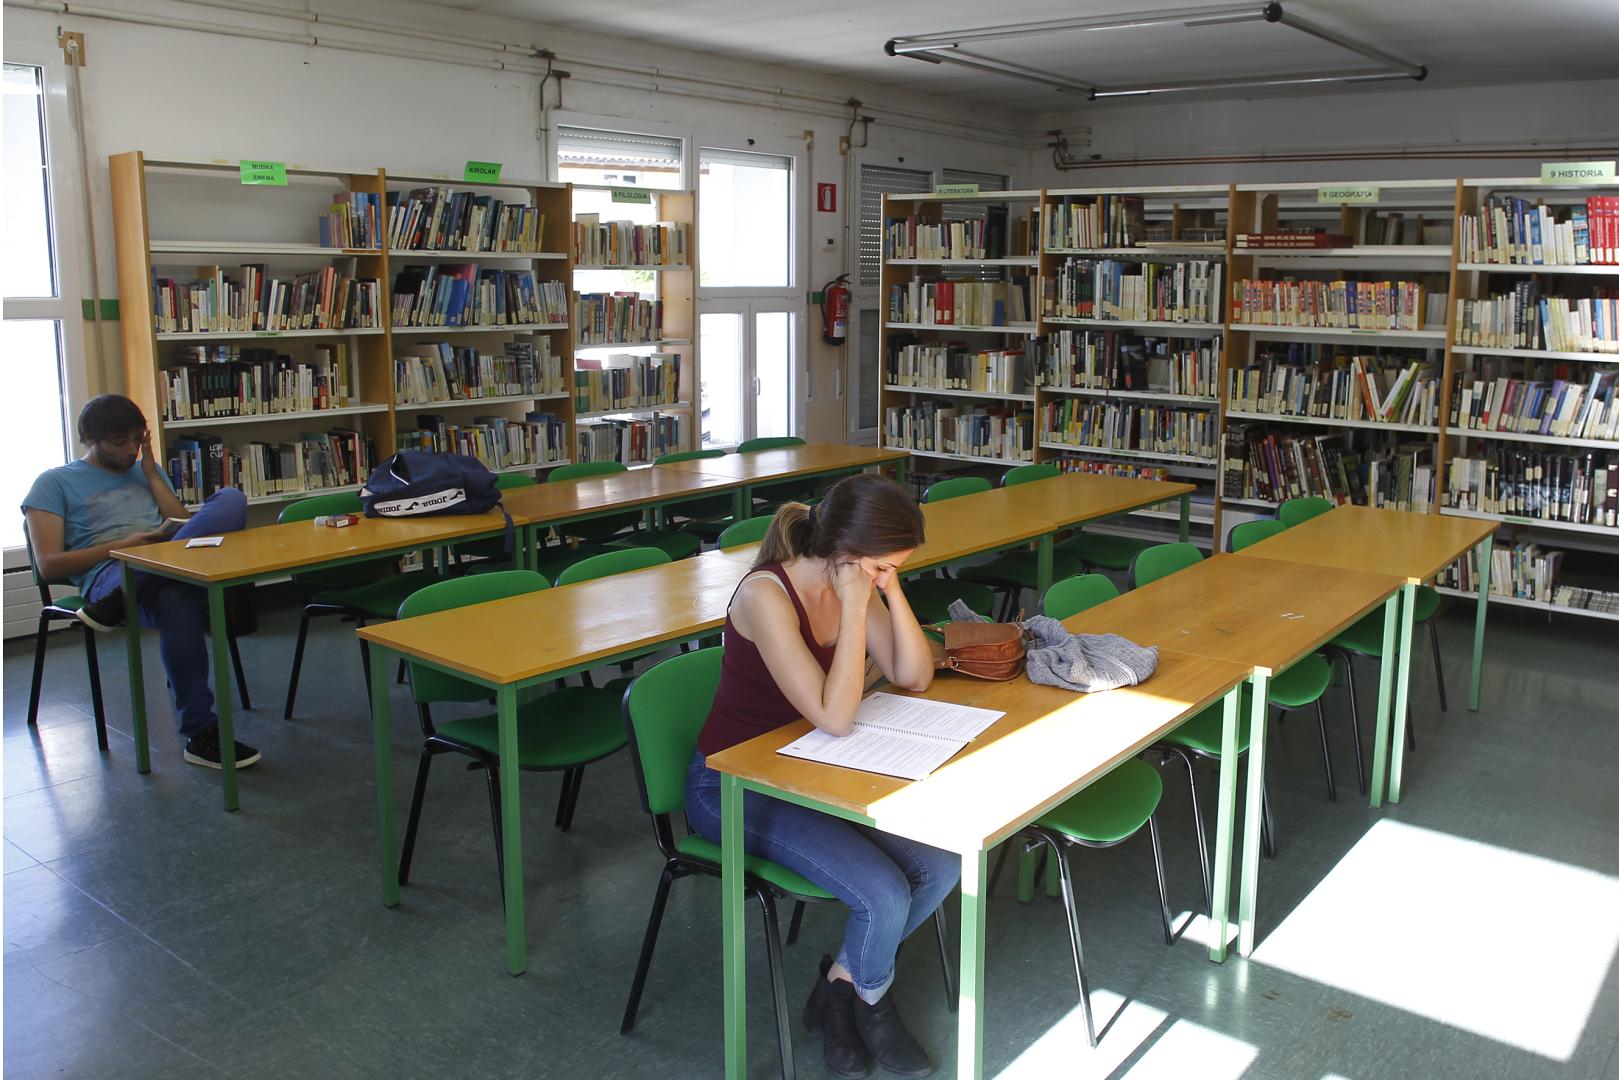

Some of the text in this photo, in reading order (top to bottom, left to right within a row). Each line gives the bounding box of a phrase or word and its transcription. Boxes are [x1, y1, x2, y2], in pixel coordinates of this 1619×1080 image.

[468, 167, 497, 175] KIROLAK
[1558, 169, 1604, 178] HISTORIA
[618, 191, 647, 199] FILOLOGIA
